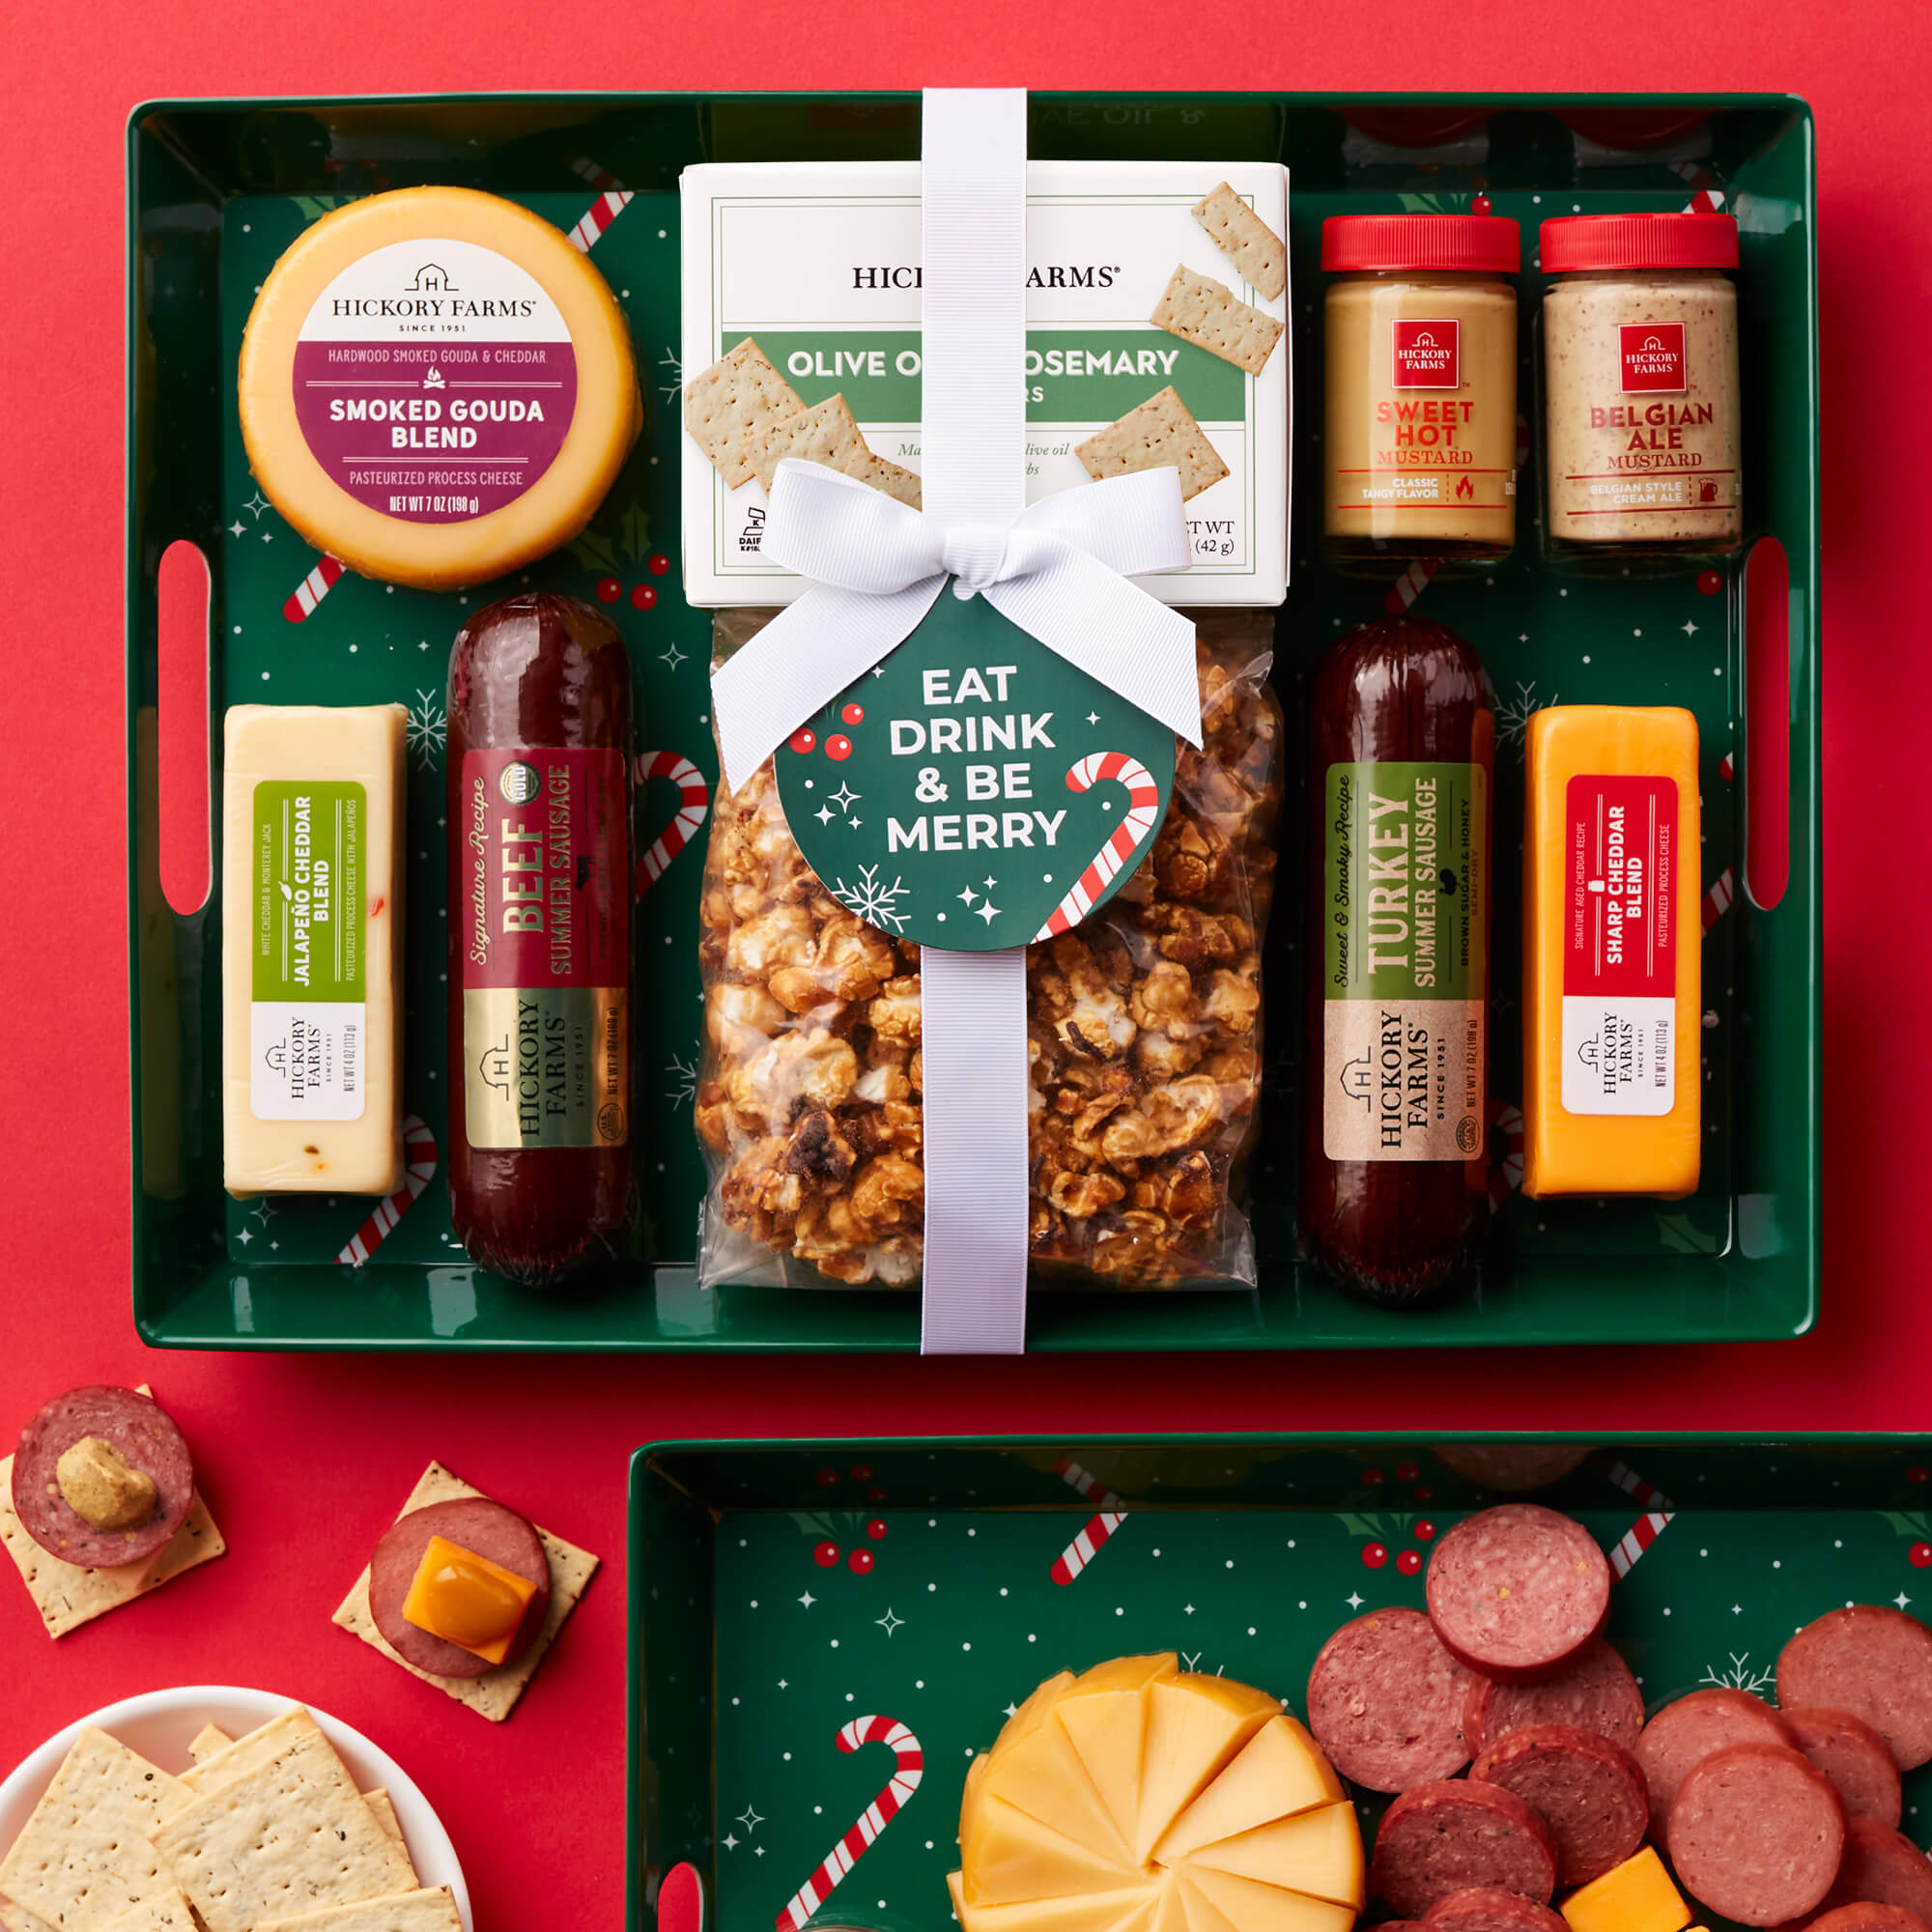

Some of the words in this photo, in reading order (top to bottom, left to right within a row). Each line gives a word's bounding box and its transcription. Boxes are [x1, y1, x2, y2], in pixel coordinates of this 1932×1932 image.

[332, 299, 444, 318] HICKORY
[328, 350, 389, 363] HARDWOOD
[392, 350, 438, 363] SMOKED
[440, 351, 479, 364] GOUDA
[482, 351, 491, 364] &
[494, 351, 547, 364] CHEDDAR
[787, 351, 886, 378] OLIVE
[1026, 350, 1180, 378] OSEMARY
[1398, 350, 1452, 361] HICKORY
[1406, 359, 1446, 371] FARMS
[1626, 352, 1680, 365] HICKORY
[1634, 362, 1674, 375] FARMS
[329, 400, 442, 422] SMOKED
[449, 400, 545, 423] GOUDA
[1377, 401, 1474, 423] SWEET
[1590, 402, 1714, 430] BELGIAN
[391, 427, 478, 449] BLEND
[1025, 442, 1049, 457] live
[1052, 442, 1070, 457] oil
[1395, 425, 1458, 447] HOT
[1628, 428, 1684, 451] ALE
[1378, 450, 1473, 466] MUSTARD
[1606, 453, 1703, 470] MUSTARD
[350, 470, 425, 486] PASTEURIZED
[428, 470, 477, 486] PROCESS
[479, 471, 524, 486] CHEESE
[1392, 477, 1438, 489] CLASSIC
[1590, 484, 1642, 496] BELGIAN
[1645, 481, 1684, 493] STYLE
[389, 496, 407, 513] NET
[408, 497, 424, 513] WT
[425, 497, 432, 513] 7
[433, 497, 447, 513] OZ
[447, 496, 468, 514] (198
[469, 497, 479, 515] g)
[1361, 488, 1395, 500] TANGY
[1396, 488, 1438, 499] FLAVOR
[1612, 494, 1657, 505] CREAM
[1659, 492, 1684, 503] ALE
[1205, 520, 1236, 534] WT
[1195, 539, 1217, 554] (42
[1220, 538, 1235, 556] g)
[922, 666, 1018, 706] EAT
[889, 712, 1057, 756] DRINK
[511, 766, 526, 802] GOLD
[914, 766, 950, 804] &
[965, 763, 1034, 802] BE
[469, 776, 490, 856] Recipe
[548, 764, 572, 868] SAUSAGE
[1335, 774, 1353, 841] Recipe
[262, 823, 271, 843] JACK
[887, 810, 1068, 853] MERRY
[1414, 778, 1437, 882] SAUSAGE
[1461, 798, 1469, 847] HONEY
[1576, 821, 1586, 848] RECIPE
[294, 796, 311, 884] CHEDDAR
[347, 843, 356, 865] WITH
[1607, 806, 1625, 895] CHEDDAR
[1660, 824, 1670, 856] CHEESE
[262, 845, 271, 885] MONTEREY
[1461, 850, 1469, 861] &
[1576, 849, 1585, 886] CHEDDAR
[346, 866, 356, 896] CHEESE
[501, 818, 544, 934] BEEF
[1334, 843, 1353, 907] Smoky
[1368, 791, 1409, 975] TURKEY
[1461, 863, 1469, 912] SUGAR
[1626, 857, 1643, 919] BLEND
[1659, 857, 1669, 893] PROCESS
[313, 860, 329, 922] BLEND
[1576, 886, 1585, 907] AGED
[261, 895, 270, 931] CHEDDAR
[346, 897, 356, 930] PROCESS
[469, 858, 491, 966] Signature
[550, 876, 573, 975] SUMMER
[1334, 911, 1350, 926] &
[1658, 895, 1669, 948] PASTEURIZED
[291, 889, 310, 987] JALAPEÑO
[1414, 889, 1437, 987] SUMMER
[1461, 917, 1469, 967] BROWN
[1575, 909, 1585, 950] SIGNATURE
[1606, 899, 1624, 965] SHARP
[261, 932, 270, 956] WHITE
[345, 930, 356, 981] PASTEURIZED
[1333, 931, 1350, 988] Sweet
[343, 1033, 356, 1049] (113
[575, 1027, 584, 1056] 1951
[1655, 1028, 1668, 1044] (113
[1655, 1044, 1667, 1055] OZ
[292, 1016, 305, 1099] HICKORY
[344, 1049, 355, 1060] OZ
[1436, 1037, 1445, 1068] 1951
[1466, 1052, 1477, 1065] OZ
[1604, 1011, 1617, 1094] HICKORY
[343, 1066, 355, 1077] WT
[519, 999, 541, 1137] HICKORY
[607, 1062, 619, 1077] WT
[1381, 1009, 1403, 1149] HICKORY
[1466, 1074, 1477, 1089] WT
[1655, 1062, 1667, 1073] WT
[1655, 1074, 1667, 1088] NET
[343, 1079, 355, 1092] NET
[575, 1064, 584, 1108] SINCE
[607, 1079, 619, 1095] NET
[1436, 1075, 1445, 1120] SINCE
[1466, 1091, 1477, 1108] NET
